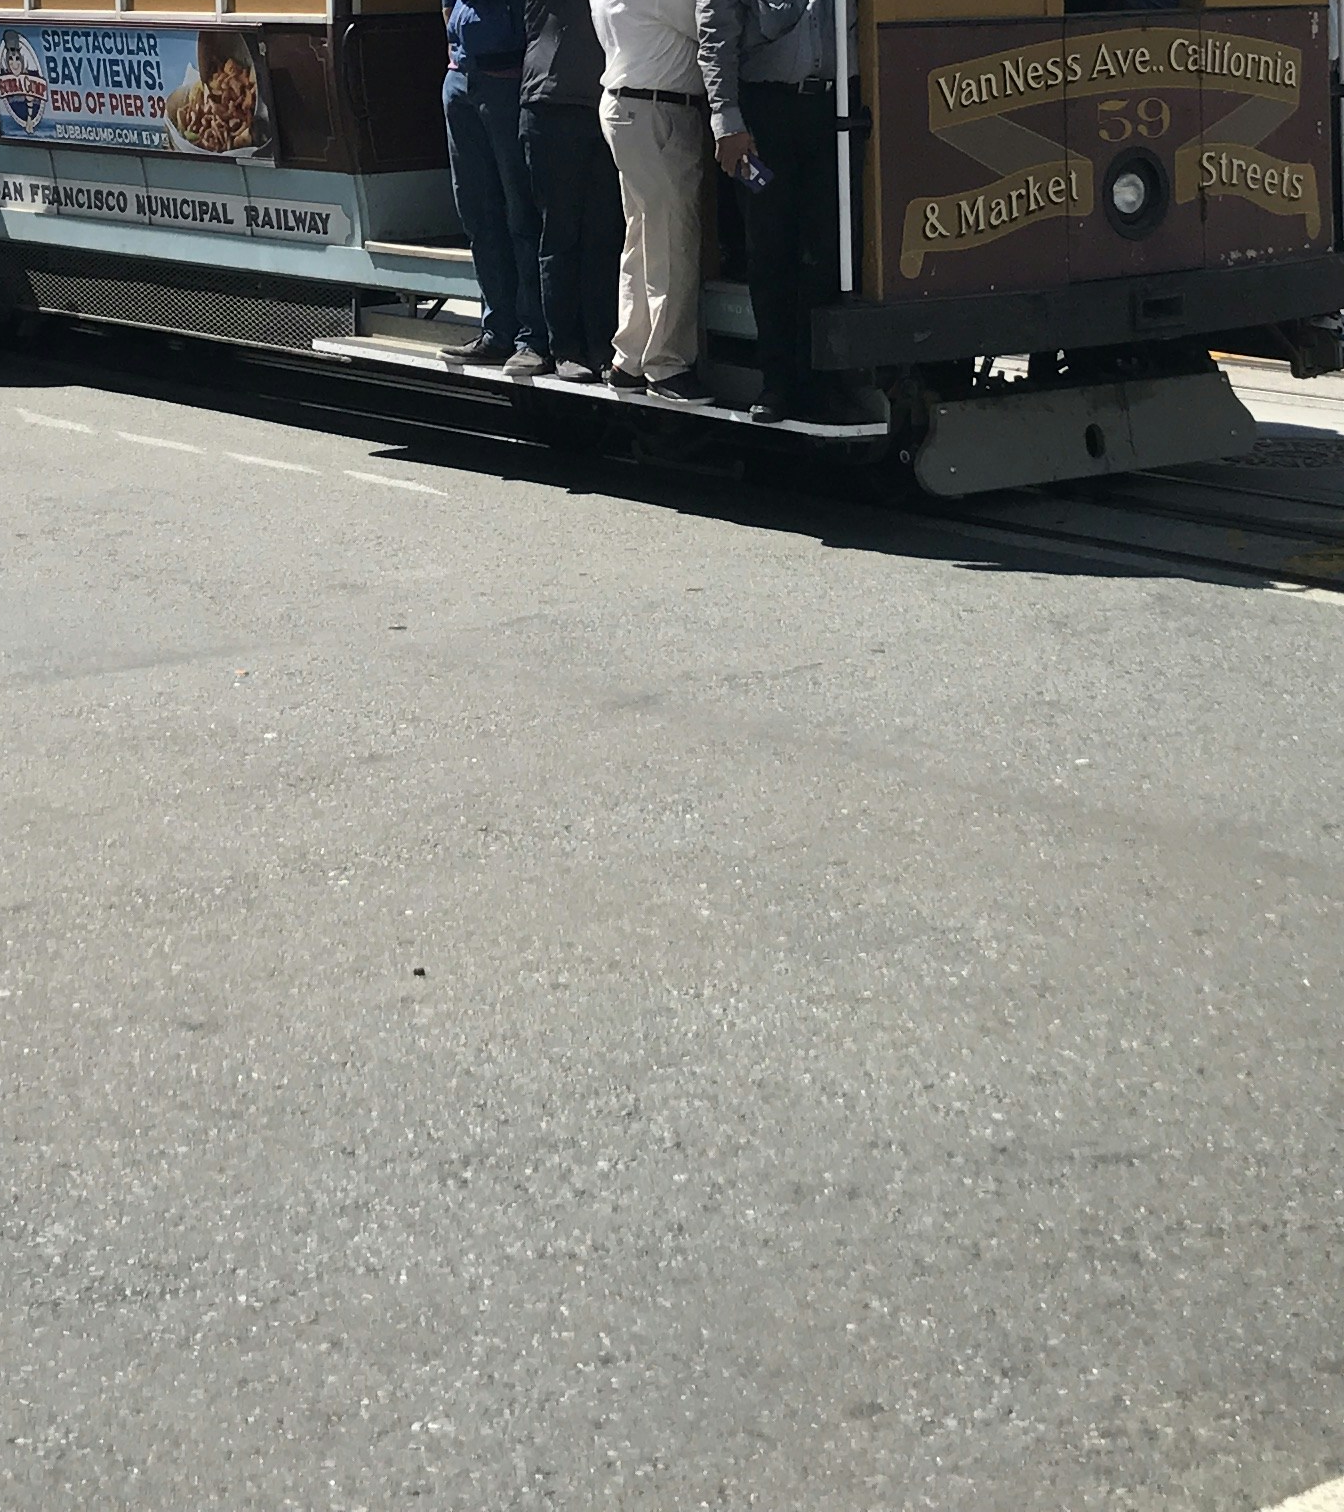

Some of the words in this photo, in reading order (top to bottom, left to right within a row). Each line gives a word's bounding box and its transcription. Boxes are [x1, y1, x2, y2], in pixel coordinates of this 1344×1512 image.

[41, 29, 159, 56] SPECTACULAR
[45, 56, 83, 86] BAY
[87, 58, 164, 91] VIEWS!
[935, 72, 999, 111] Van
[1001, 56, 1083, 96] Ness
[1168, 38, 1298, 87] California
[50, 90, 82, 113] END
[85, 91, 106, 115] OF
[109, 93, 145, 118] PIER
[147, 95, 167, 119] 39
[1097, 97, 1171, 142] 59
[56, 124, 140, 144] BUBBAGUMP.COM
[29, 183, 129, 214] FRANCISCO
[244, 205, 332, 235] RAILWAY
[923, 202, 950, 239] &
[957, 169, 1079, 235] Market
[1200, 151, 1304, 199] Streets
